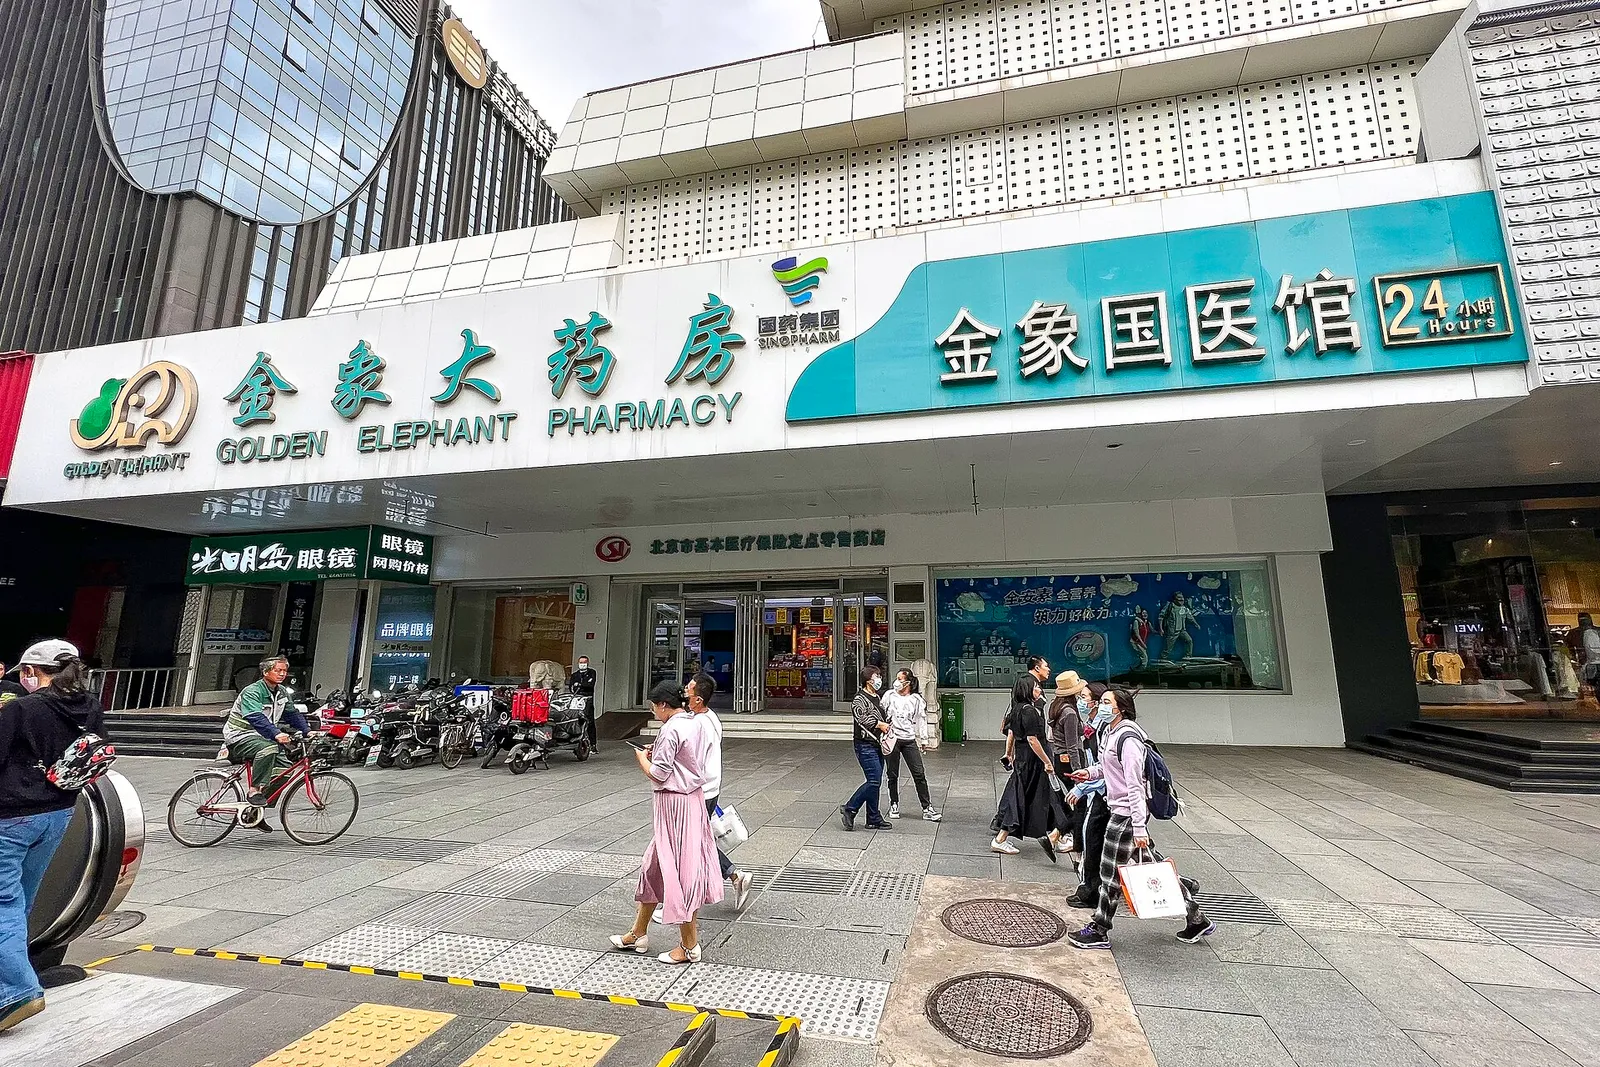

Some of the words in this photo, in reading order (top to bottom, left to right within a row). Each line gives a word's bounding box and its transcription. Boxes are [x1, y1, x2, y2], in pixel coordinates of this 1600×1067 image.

[1384, 279, 1448, 338] 24
[1456, 297, 1495, 317] 小时
[758, 309, 840, 337] 国药集团
[935, 267, 1362, 383] 金象国医馆
[1428, 318, 1496, 336] Hours
[758, 330, 840, 349] SINOPHARM
[224, 293, 746, 428] 金象大药房
[216, 430, 328, 464] GOLDEN
[357, 411, 518, 453] ELEPHANT
[548, 392, 742, 436] PHARMACY
[381, 533, 425, 556] 眼镜
[649, 529, 886, 555] 北京市基本医疗保险定点零售药店
[373, 556, 430, 576] 网购价格
[1056, 586, 1097, 602] 全营养
